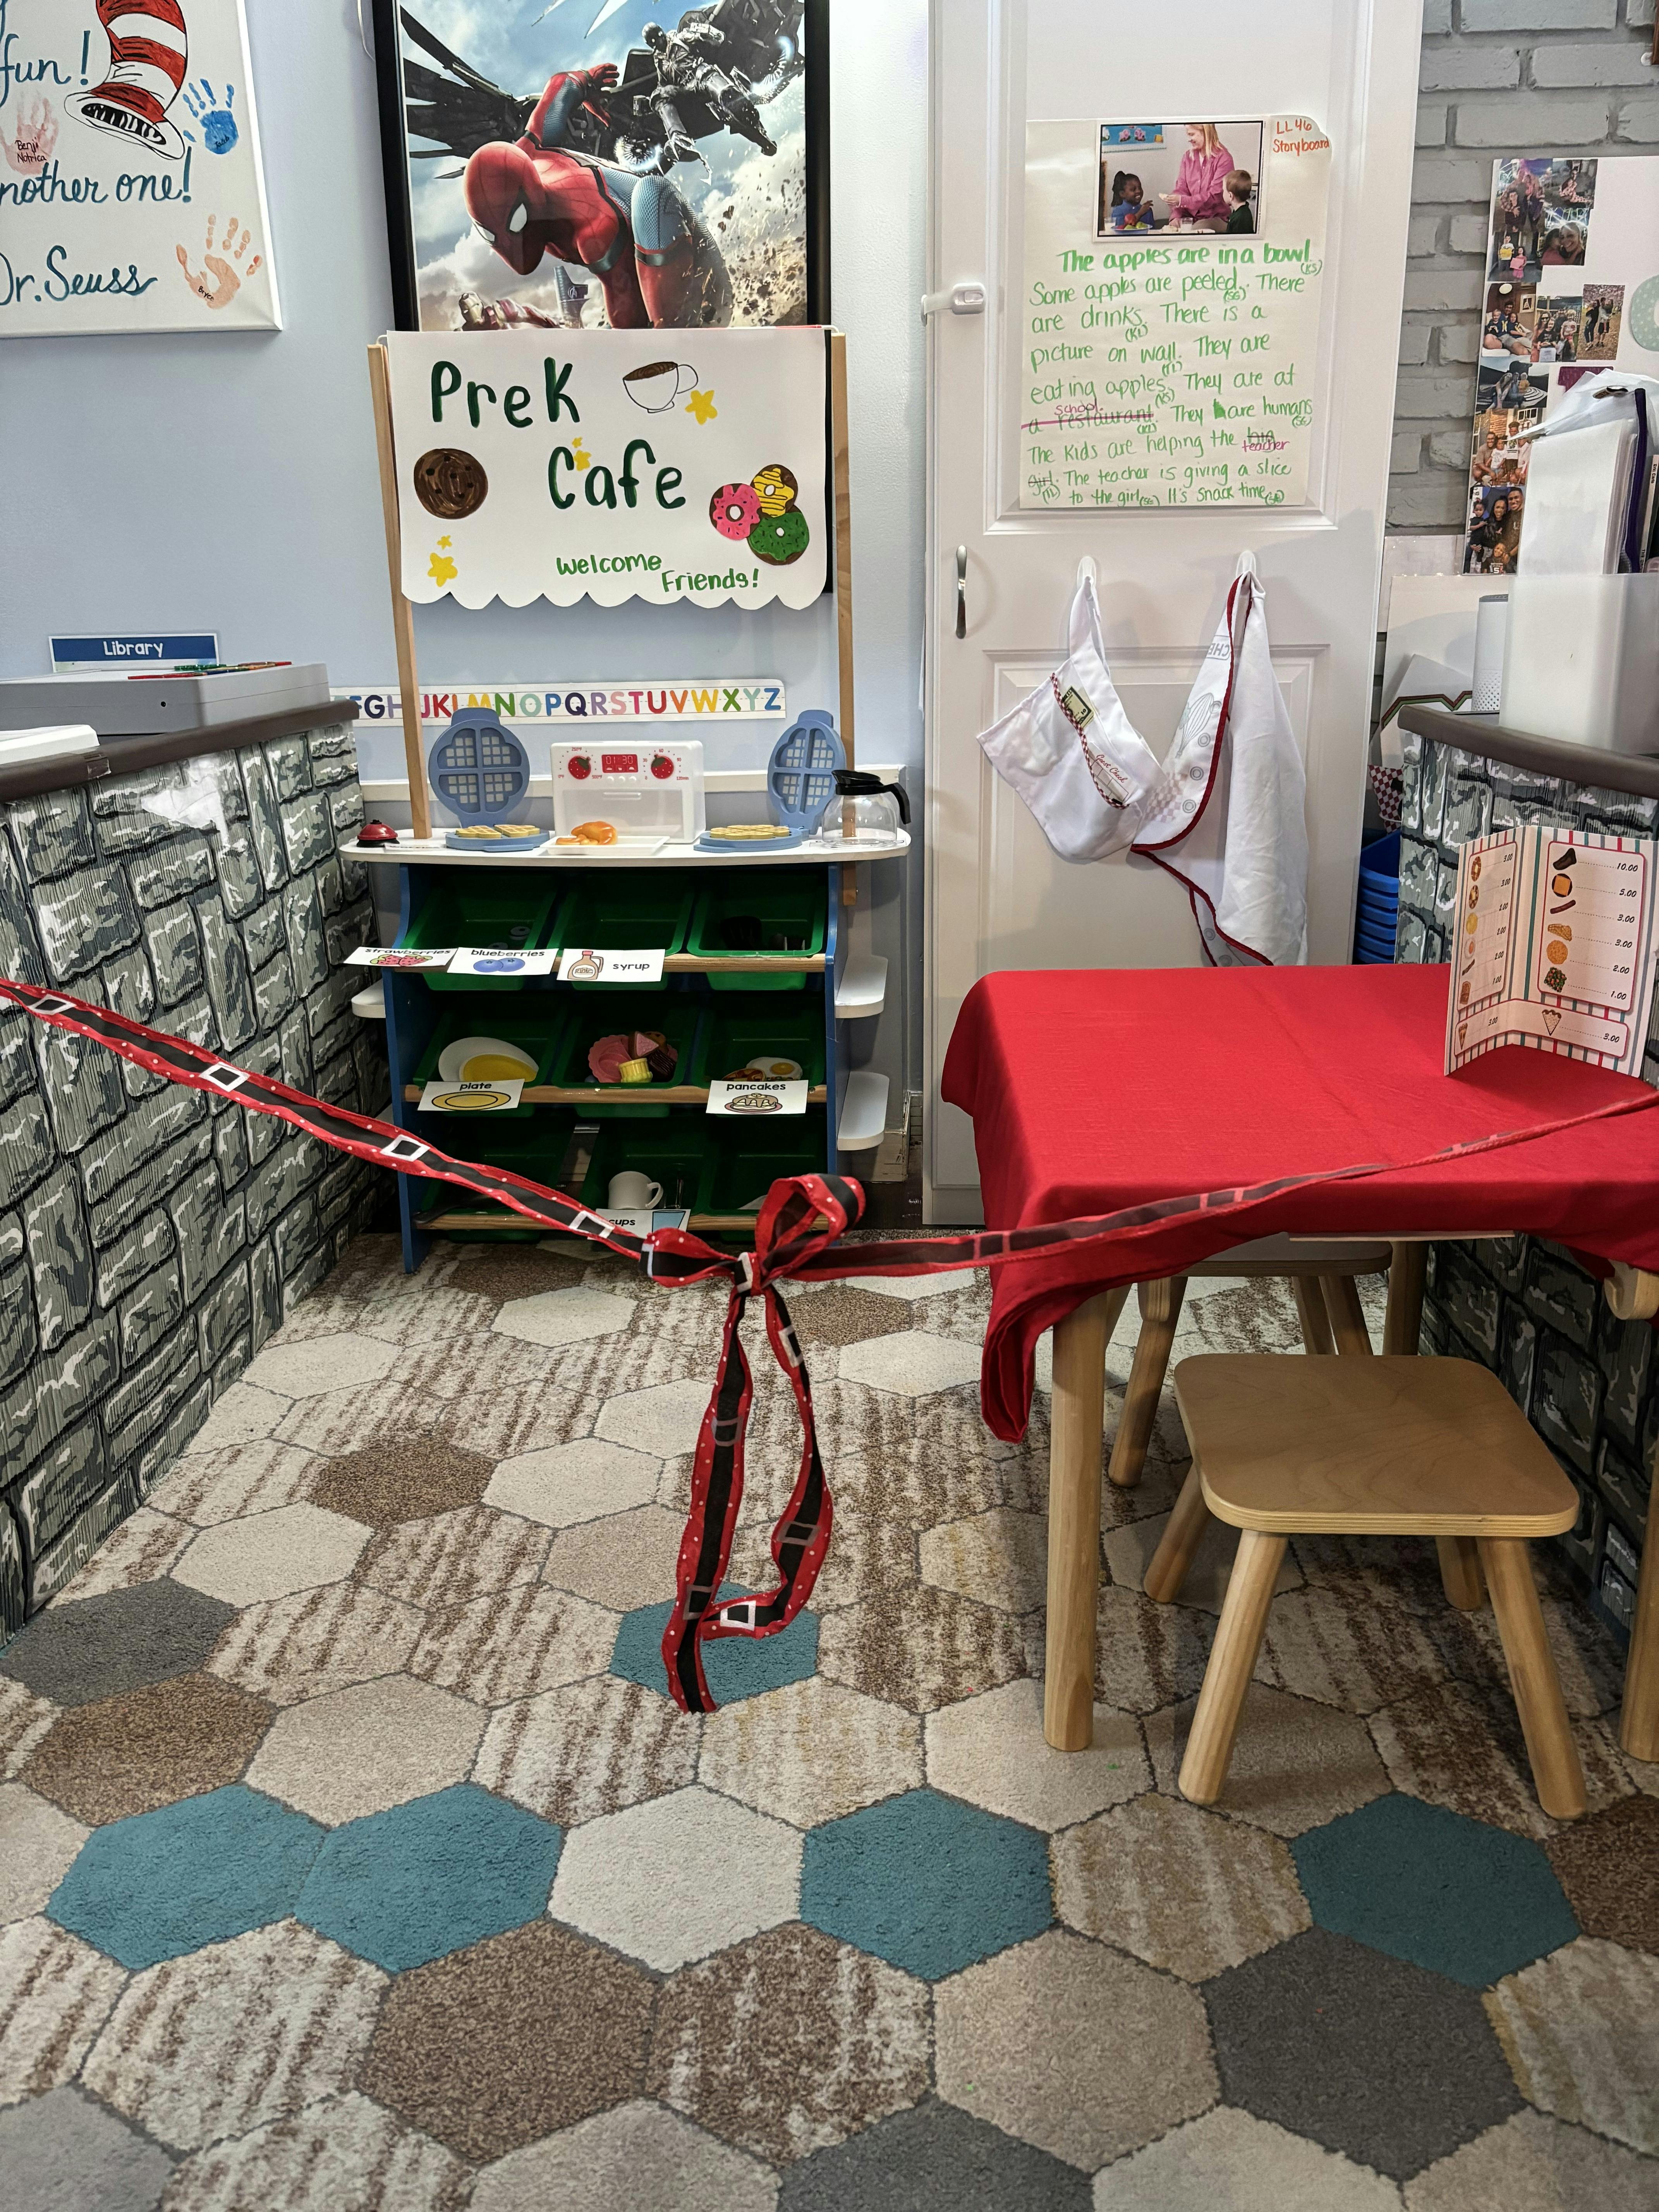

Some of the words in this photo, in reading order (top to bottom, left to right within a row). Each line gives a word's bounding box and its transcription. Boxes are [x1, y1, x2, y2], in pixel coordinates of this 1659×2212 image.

[0, 30, 91, 108] fun!
[1295, 118, 1312, 131] 46
[15, 137, 38, 153] Benji
[1273, 136, 1329, 156] Storyboard
[116, 146, 192, 204] one!
[1056, 250, 1094, 272] The
[1103, 248, 1173, 273] apples
[1178, 247, 1210, 264] are
[1218, 244, 1238, 264] in
[1240, 248, 1254, 264] a
[45, 245, 158, 301] Seuss
[198, 285, 215, 301] Bryce
[1029, 282, 1078, 306] Some
[1084, 276, 1136, 304] apples
[1145, 276, 1173, 294] are
[1255, 273, 1305, 293] There
[1032, 314, 1066, 333] are
[1159, 302, 1211, 323] There
[1223, 305, 1238, 321] is
[1251, 305, 1267, 319] a
[1030, 343, 1094, 374] picture
[1108, 347, 1127, 362] on
[1140, 341, 1182, 364] wall.
[1193, 335, 1232, 360] They
[1241, 333, 1271, 353] are
[1030, 375, 1097, 405] eating
[1183, 372, 1223, 395] They
[1233, 372, 1263, 388] are
[1274, 363, 1295, 386] at
[1170, 404, 1203, 426] They
[1262, 395, 1313, 416] humans
[1027, 446, 1056, 464] The
[1108, 440, 1137, 459] are
[1147, 435, 1204, 458] helping
[1210, 429, 1238, 447] the
[1242, 439, 1290, 453] teacher
[548, 439, 686, 510] Cafe
[1063, 469, 1090, 486] The
[1160, 464, 1177, 480] is
[1183, 462, 1228, 489] giving
[1238, 464, 1250, 476] a
[1256, 457, 1292, 476] slice
[1069, 490, 1083, 505] to
[1091, 488, 1114, 505] the
[1168, 488, 1187, 504] It's
[1197, 487, 1235, 502] snack
[661, 568, 759, 592] Friends!
[103, 641, 163, 658] Library
[1109, 767, 1128, 783] Check
[1616, 862, 1638, 872] 10.00
[1619, 888, 1637, 898] 5.00
[1617, 914, 1635, 924] 3.00
[1614, 939, 1633, 949] 3.00
[1494, 951, 1504, 960] 2.00
[1613, 964, 1630, 974] 2.00
[1492, 975, 1502, 985] 1.00
[1611, 990, 1627, 1000] 1.00
[1488, 1016, 1498, 1027] 3.00
[1603, 1033, 1620, 1043] 3.00
[459, 1082, 492, 1091] plate
[726, 1083, 786, 1091] pancakes
